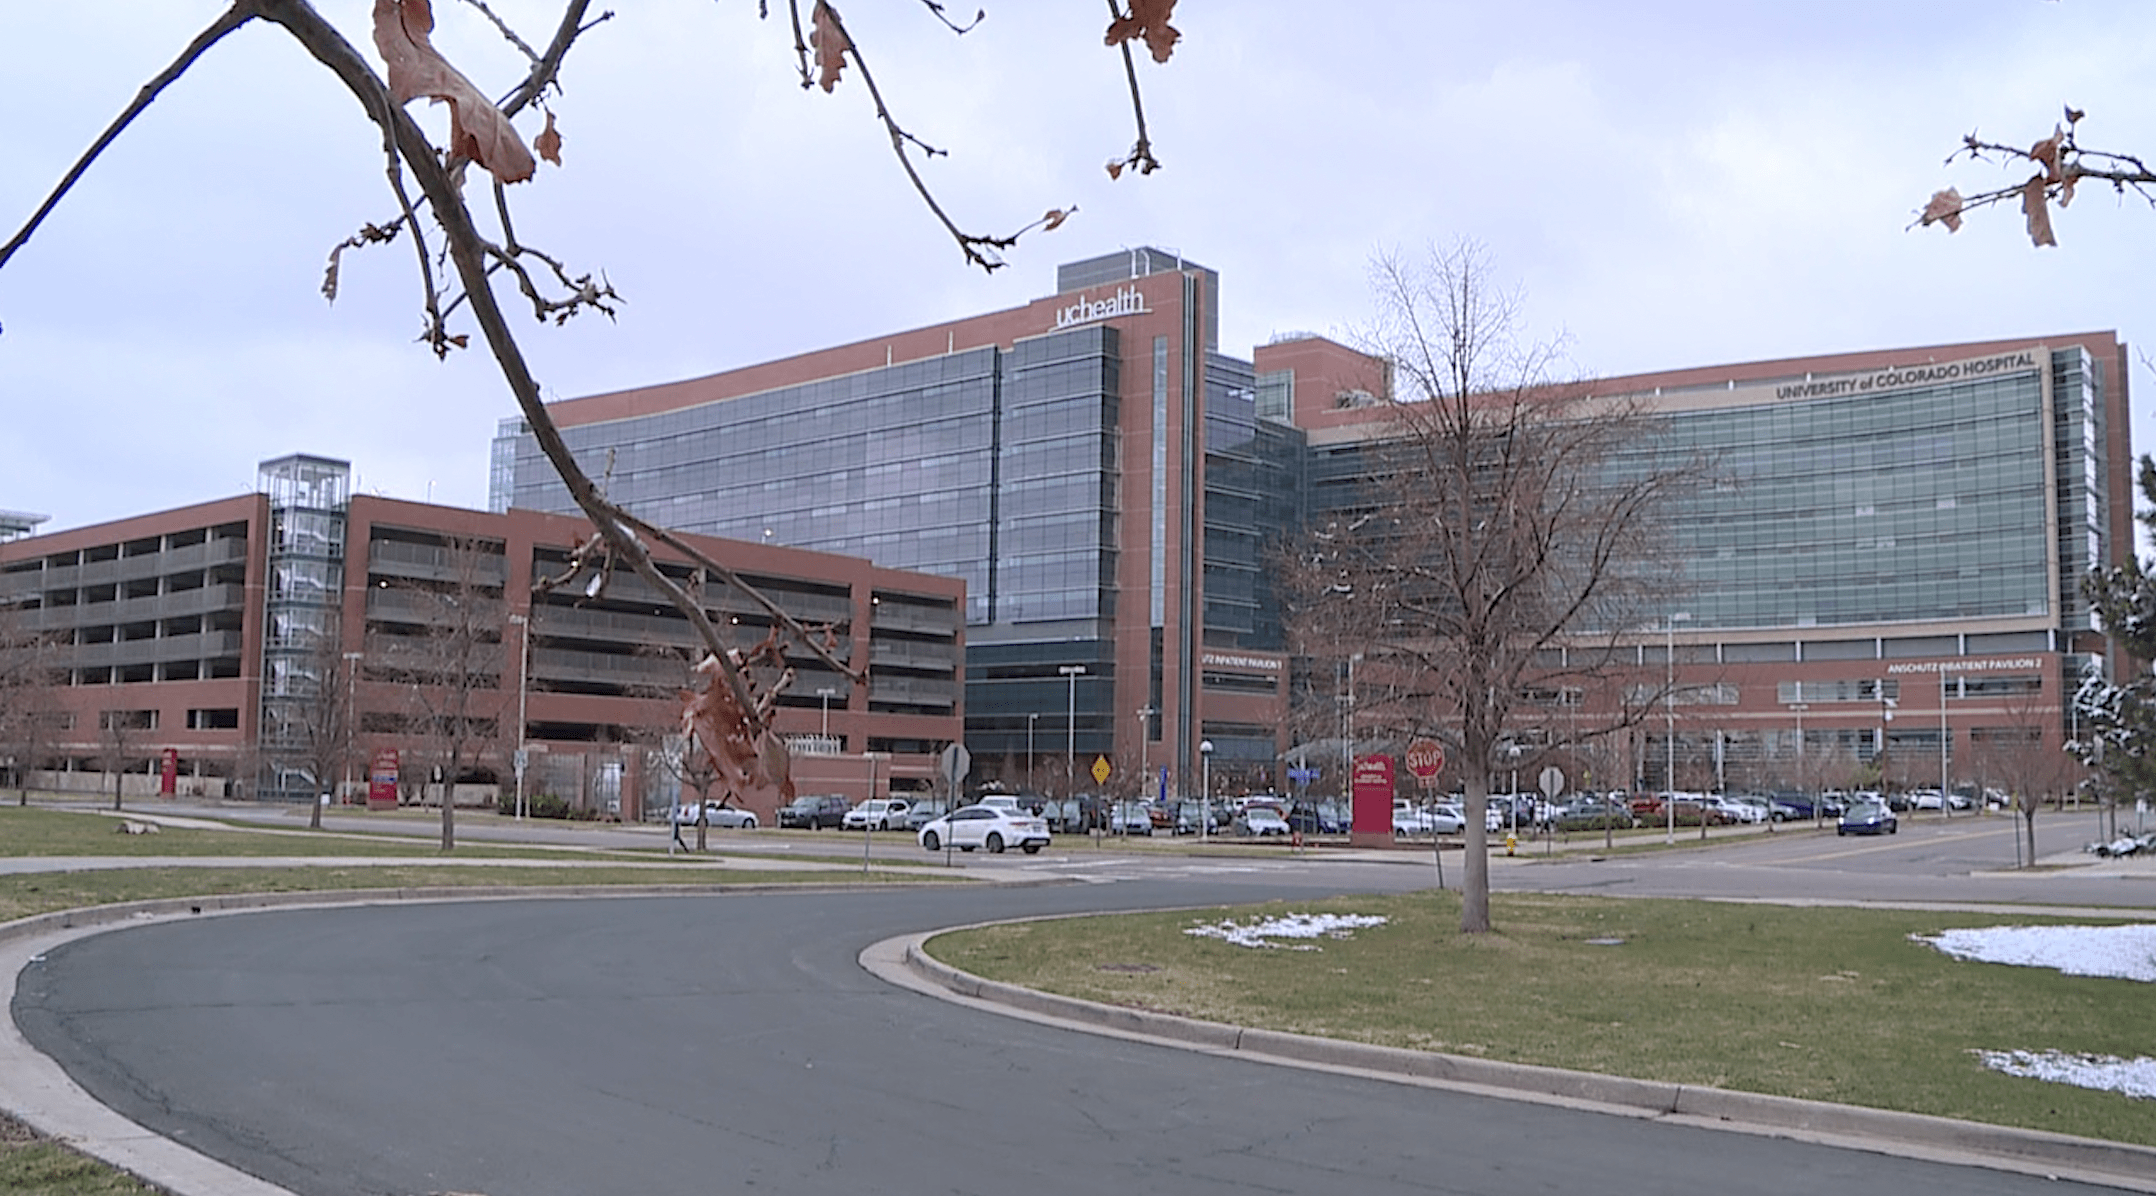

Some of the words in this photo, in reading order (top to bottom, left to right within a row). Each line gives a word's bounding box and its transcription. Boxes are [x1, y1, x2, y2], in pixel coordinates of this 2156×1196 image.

[1056, 284, 1145, 327] uchealth
[1776, 379, 1857, 400] UNIVERSITY
[1860, 376, 1873, 391] of
[1876, 364, 1960, 388] COLORADO
[1963, 352, 2035, 376] HOSPITAL
[1887, 662, 1938, 674] ANSCHUTZ
[1988, 658, 2034, 671] PAVILION
[1409, 750, 1442, 768] STOP
